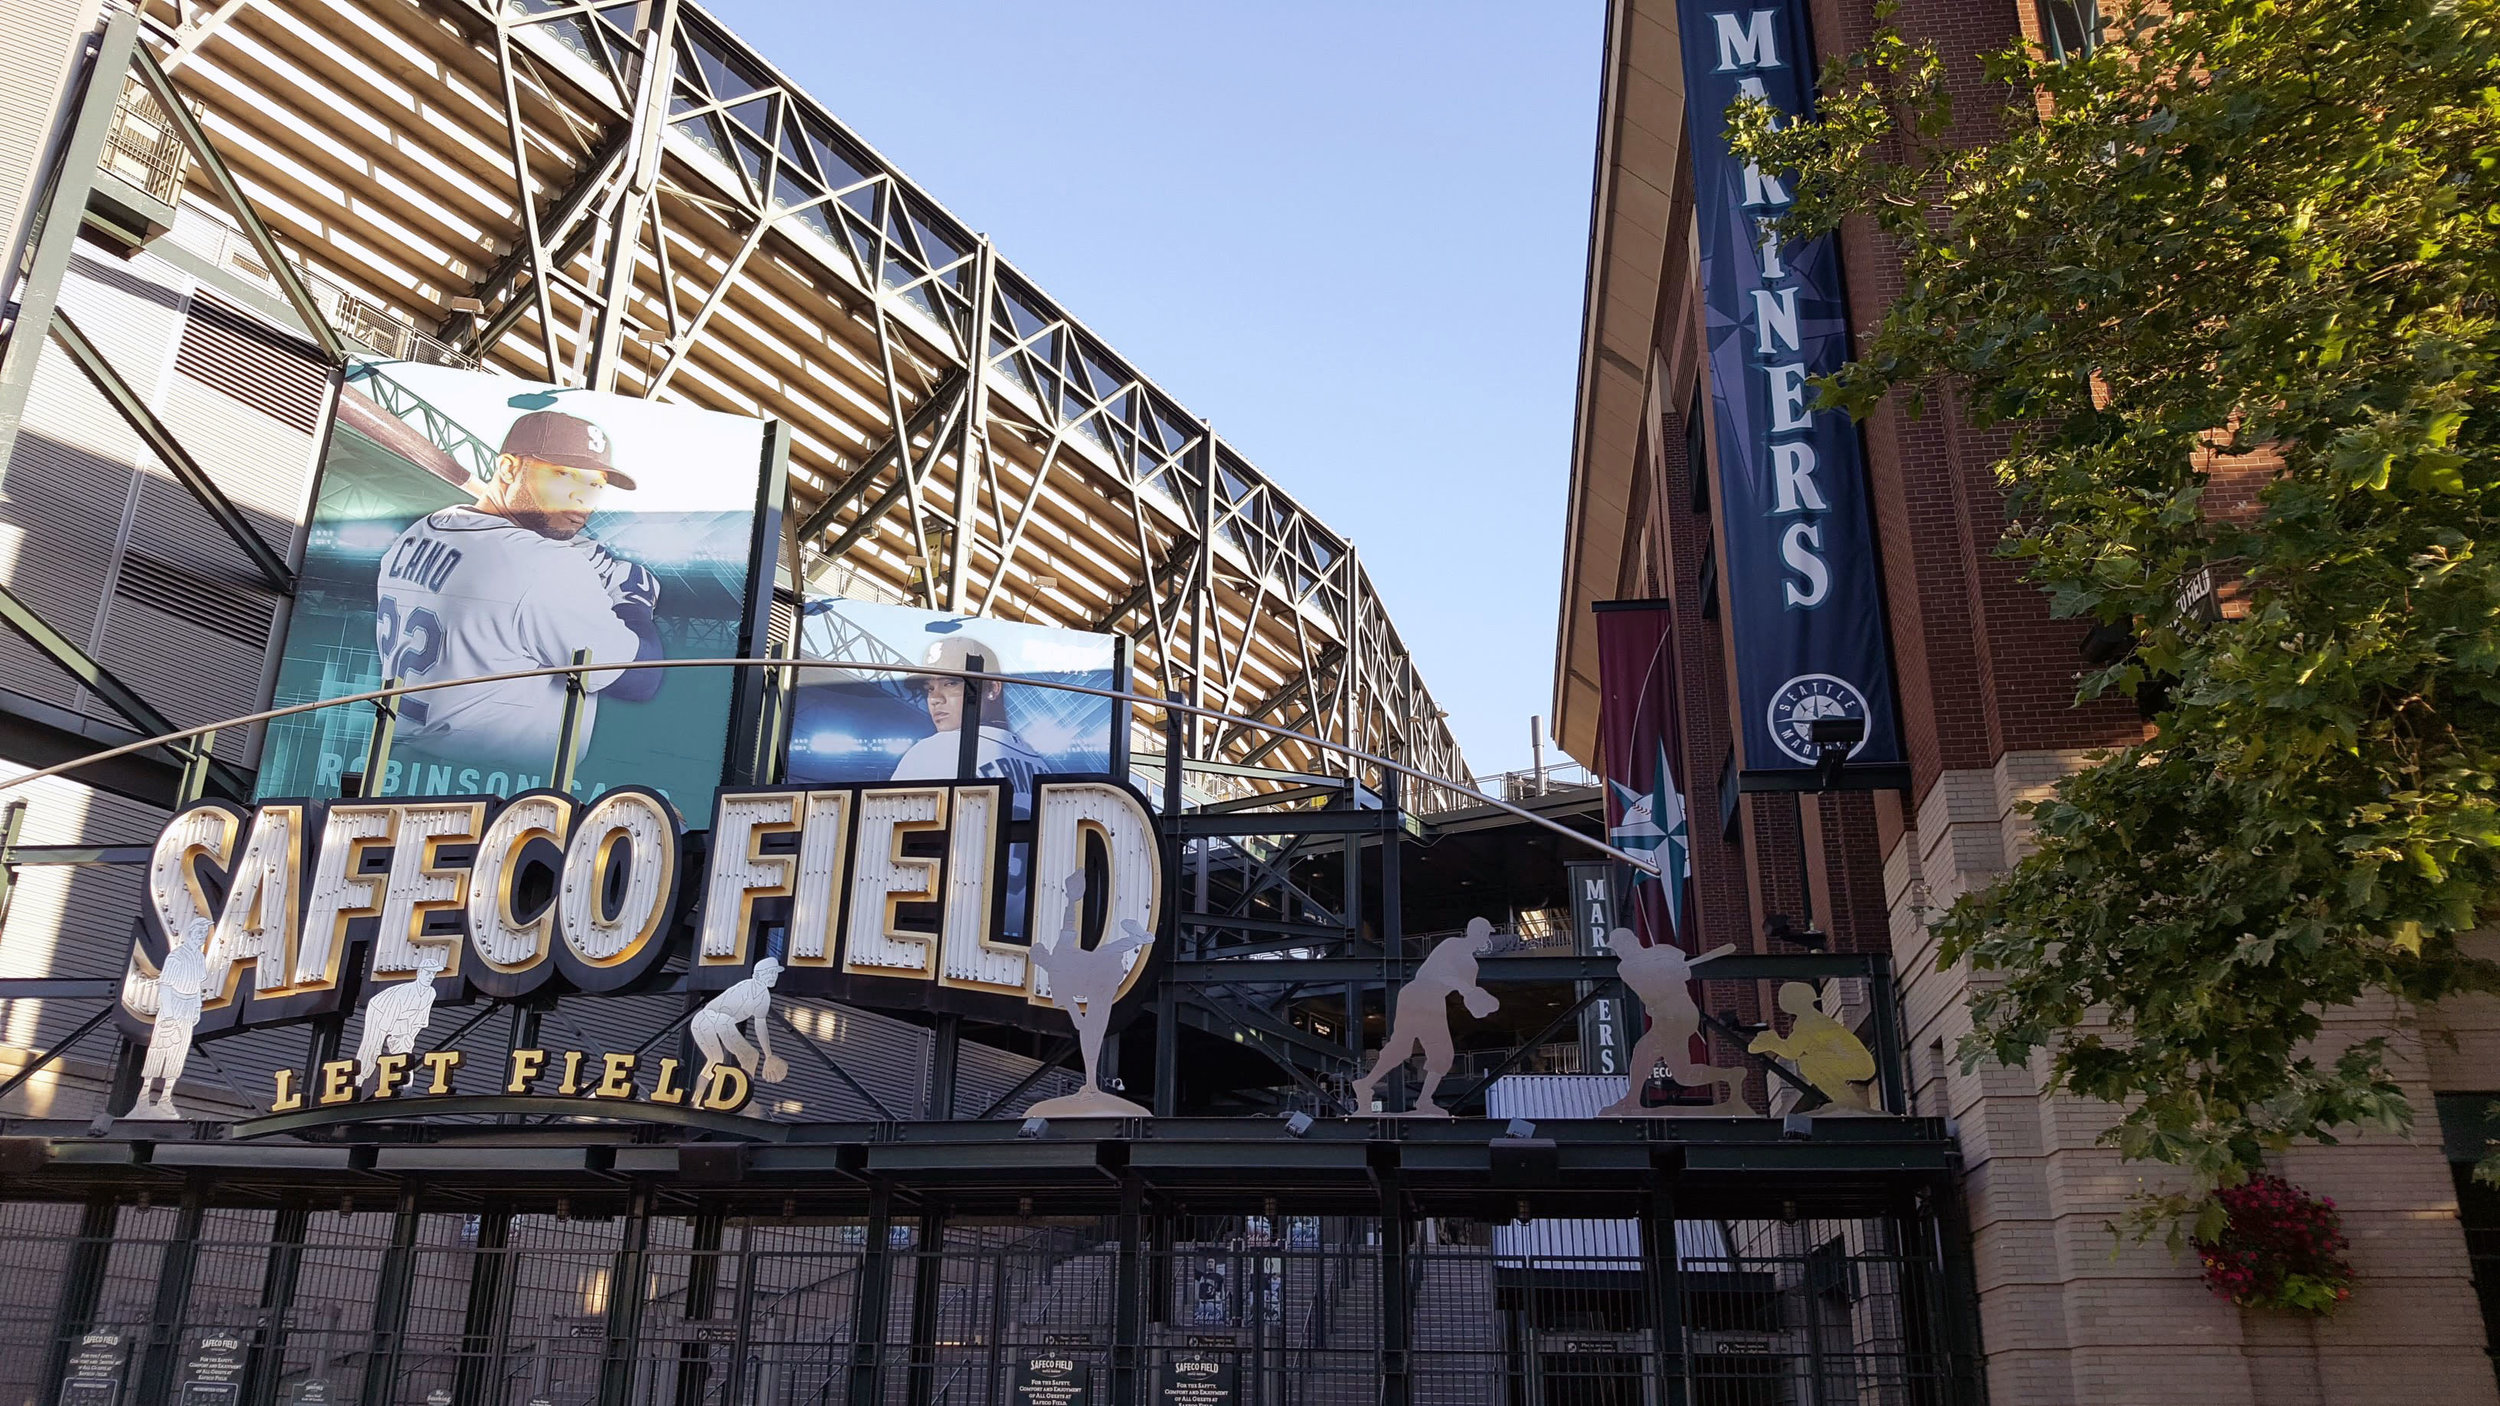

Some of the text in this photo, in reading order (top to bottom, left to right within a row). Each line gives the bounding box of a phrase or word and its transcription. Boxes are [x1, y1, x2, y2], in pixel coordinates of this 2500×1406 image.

[388, 536, 463, 595] CANO
[1779, 682, 1857, 712] SEATTLE
[316, 752, 541, 804] RBINSON
[120, 782, 1162, 1026] SAFECO FIELD
[1585, 879, 1615, 1075] MARERS
[271, 1048, 752, 1113] LEFT FIELD
[201, 1339, 238, 1350] SAFECO FIELD
[1030, 1360, 1073, 1371] SAFECO FIELD
[1175, 1363, 1219, 1374] SAFECO FIELD
